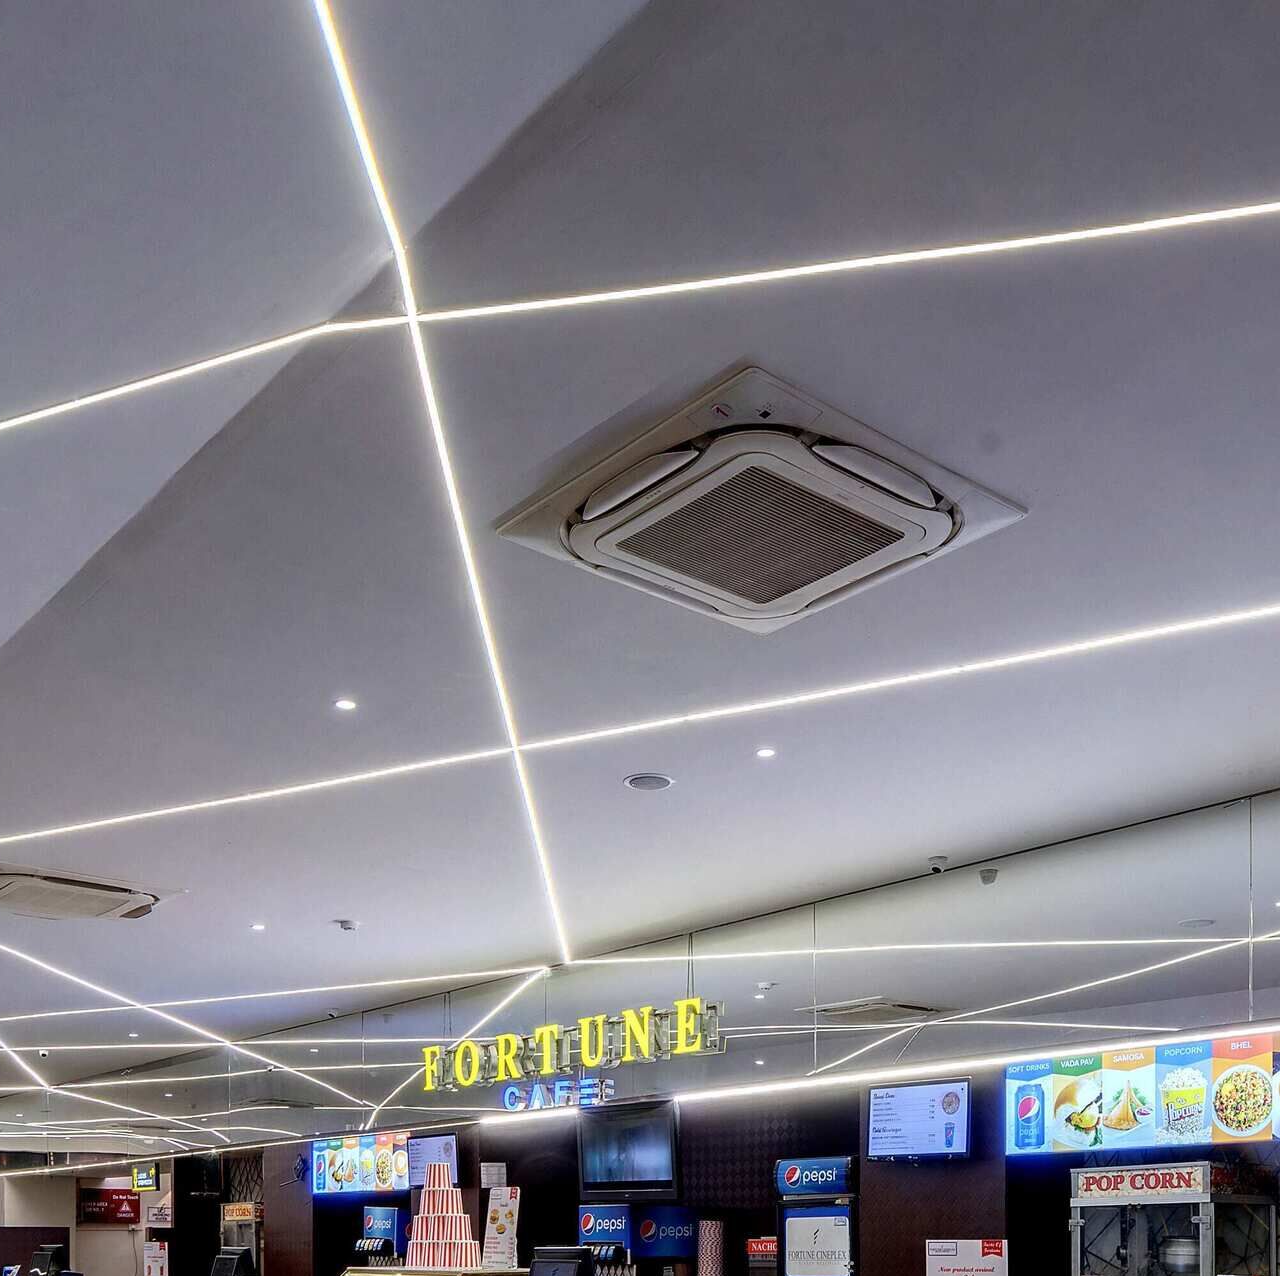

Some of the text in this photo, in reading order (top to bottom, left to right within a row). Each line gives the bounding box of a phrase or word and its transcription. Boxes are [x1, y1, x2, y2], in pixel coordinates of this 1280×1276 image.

[422, 997, 702, 1091] FORTUNE
[1230, 1041, 1253, 1050] BHEL
[1112, 1052, 1145, 1062] SAMOSA
[1164, 1046, 1203, 1057] POPCORN
[1007, 1063, 1050, 1074] SOFT DRINKS
[1060, 1057, 1094, 1069] VADA PAV
[802, 1167, 837, 1184] pepsi
[1084, 1171, 1194, 1192] POP CORN
[373, 1218, 393, 1231] pepsi
[596, 1215, 626, 1233] pepsi
[659, 1223, 693, 1240] pepsi
[788, 1249, 847, 1261] FORTUNE CINEPLEX
